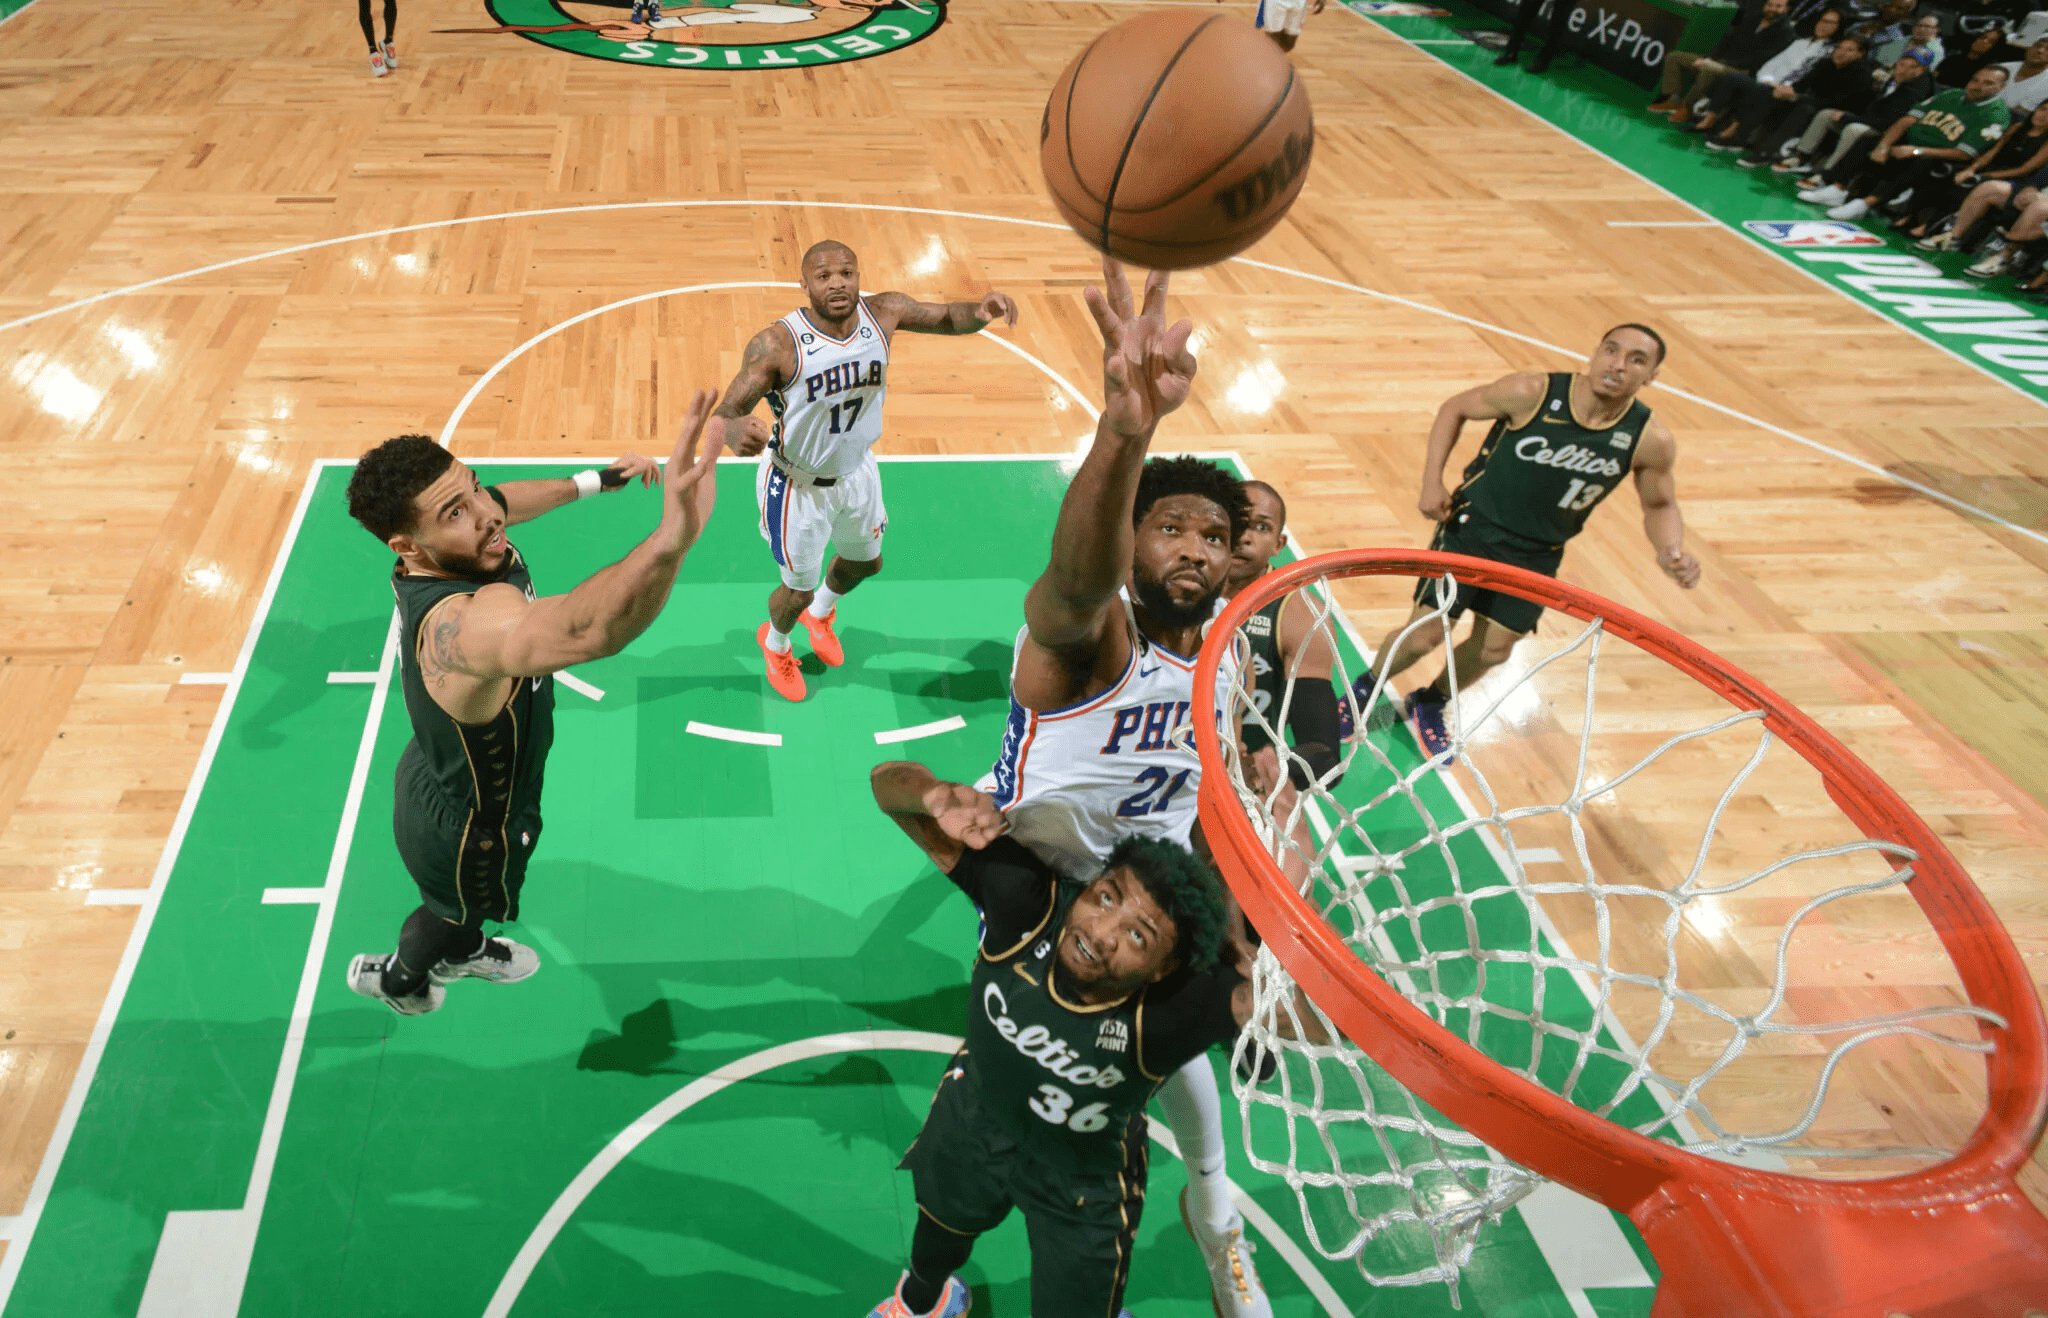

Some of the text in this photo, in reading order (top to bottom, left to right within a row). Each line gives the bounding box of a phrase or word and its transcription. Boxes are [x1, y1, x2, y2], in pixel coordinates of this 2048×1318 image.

[619, 25, 912, 65] CELTICS
[1587, 8, 1665, 67] X-Pro
[805, 360, 882, 403] PHILA
[829, 396, 863, 434] 17
[1515, 435, 1621, 477] Celtics
[1558, 478, 1604, 510] 13
[1246, 624, 1272, 636] PRINT
[1114, 766, 1192, 817] 21
[984, 982, 1126, 1088] Celtics
[1095, 1036, 1128, 1053] PRINT
[1099, 1019, 1129, 1041] VISTA
[1028, 1083, 1112, 1133] 36
